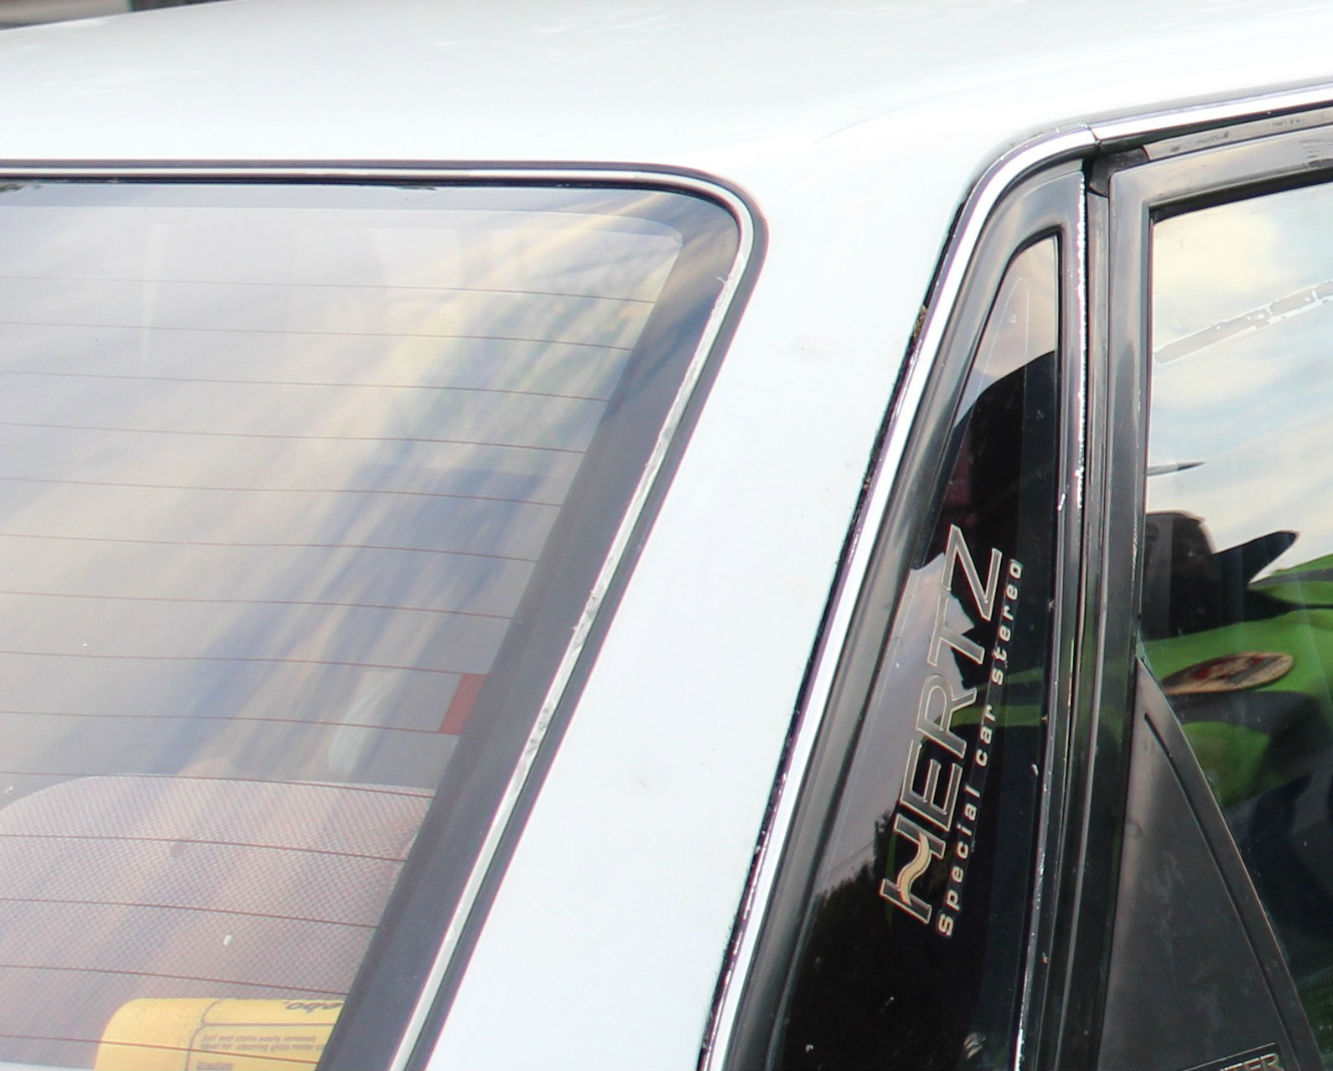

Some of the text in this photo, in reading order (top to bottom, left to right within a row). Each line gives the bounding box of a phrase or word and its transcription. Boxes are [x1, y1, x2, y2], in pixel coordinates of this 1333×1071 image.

[879, 524, 1003, 925] HERTZ
[937, 559, 1024, 937] Special car stereo
